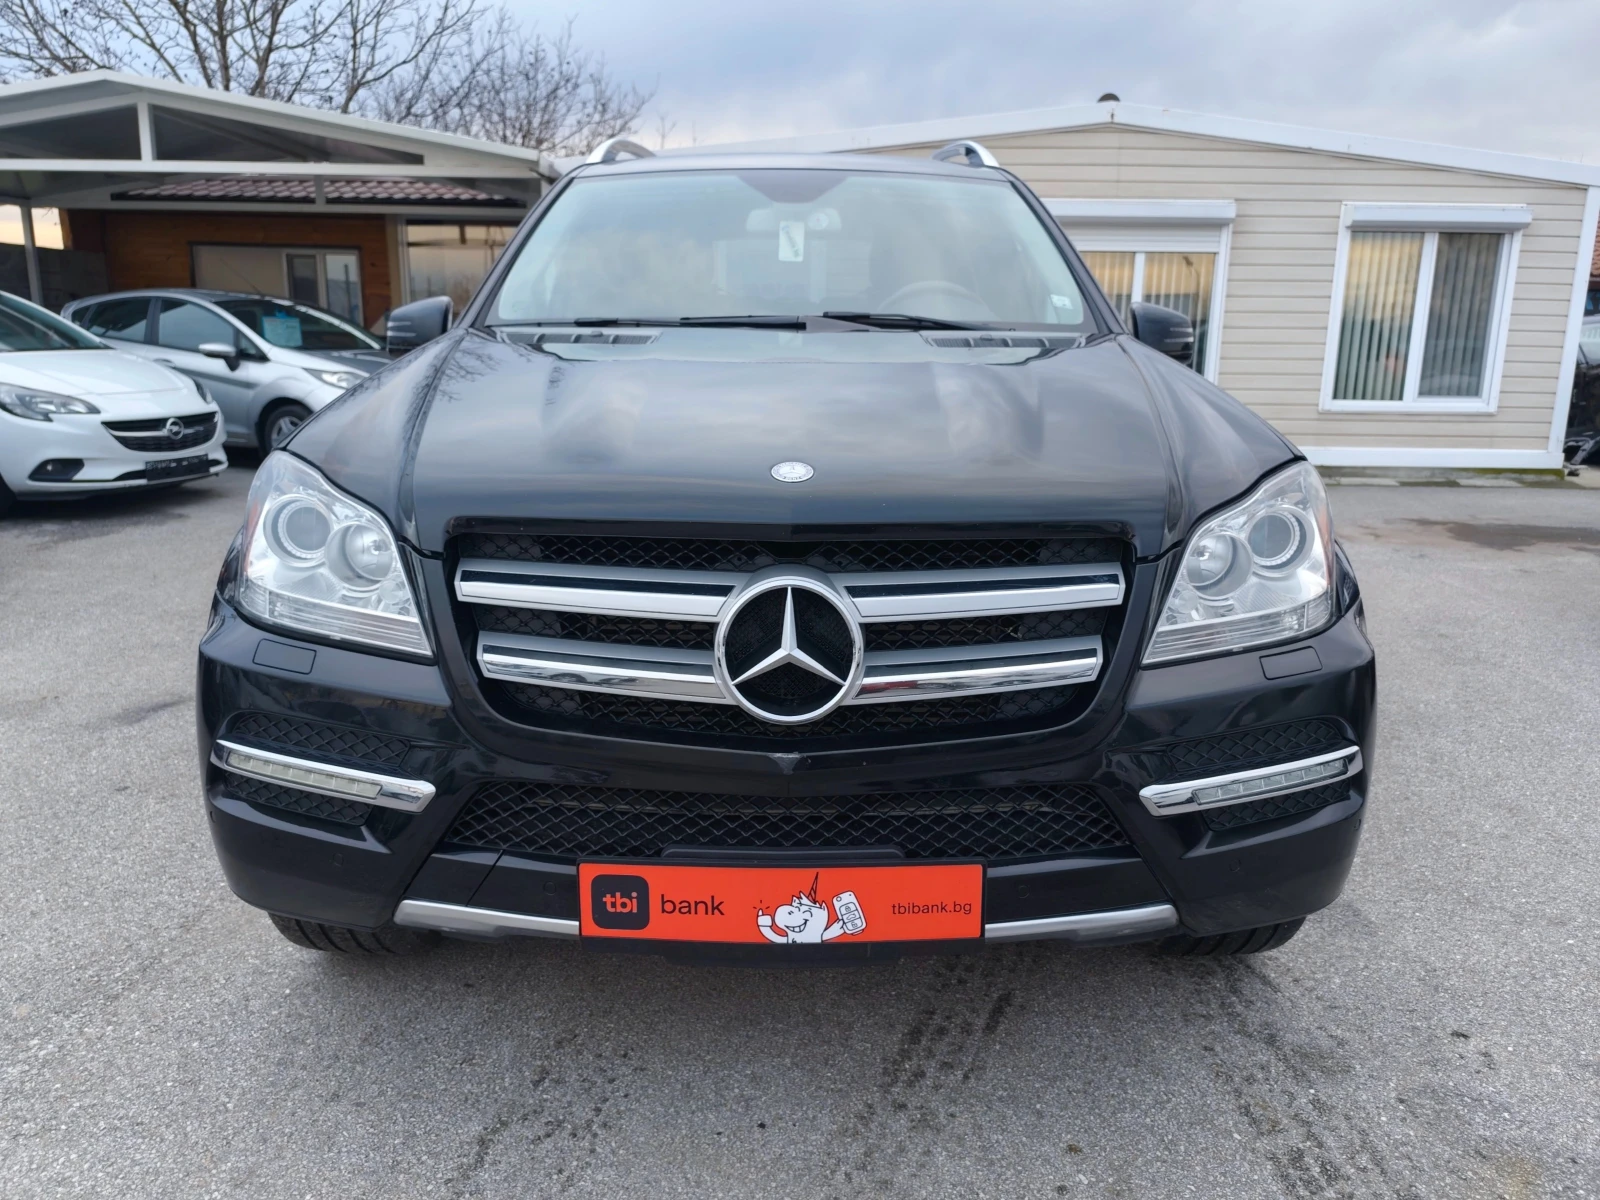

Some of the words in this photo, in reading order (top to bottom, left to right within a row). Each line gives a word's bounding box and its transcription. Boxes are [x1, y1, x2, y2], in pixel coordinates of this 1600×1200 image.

[602, 891, 638, 914] tbi
[660, 893, 725, 916] bank
[891, 900, 972, 915] tbibank.bg
